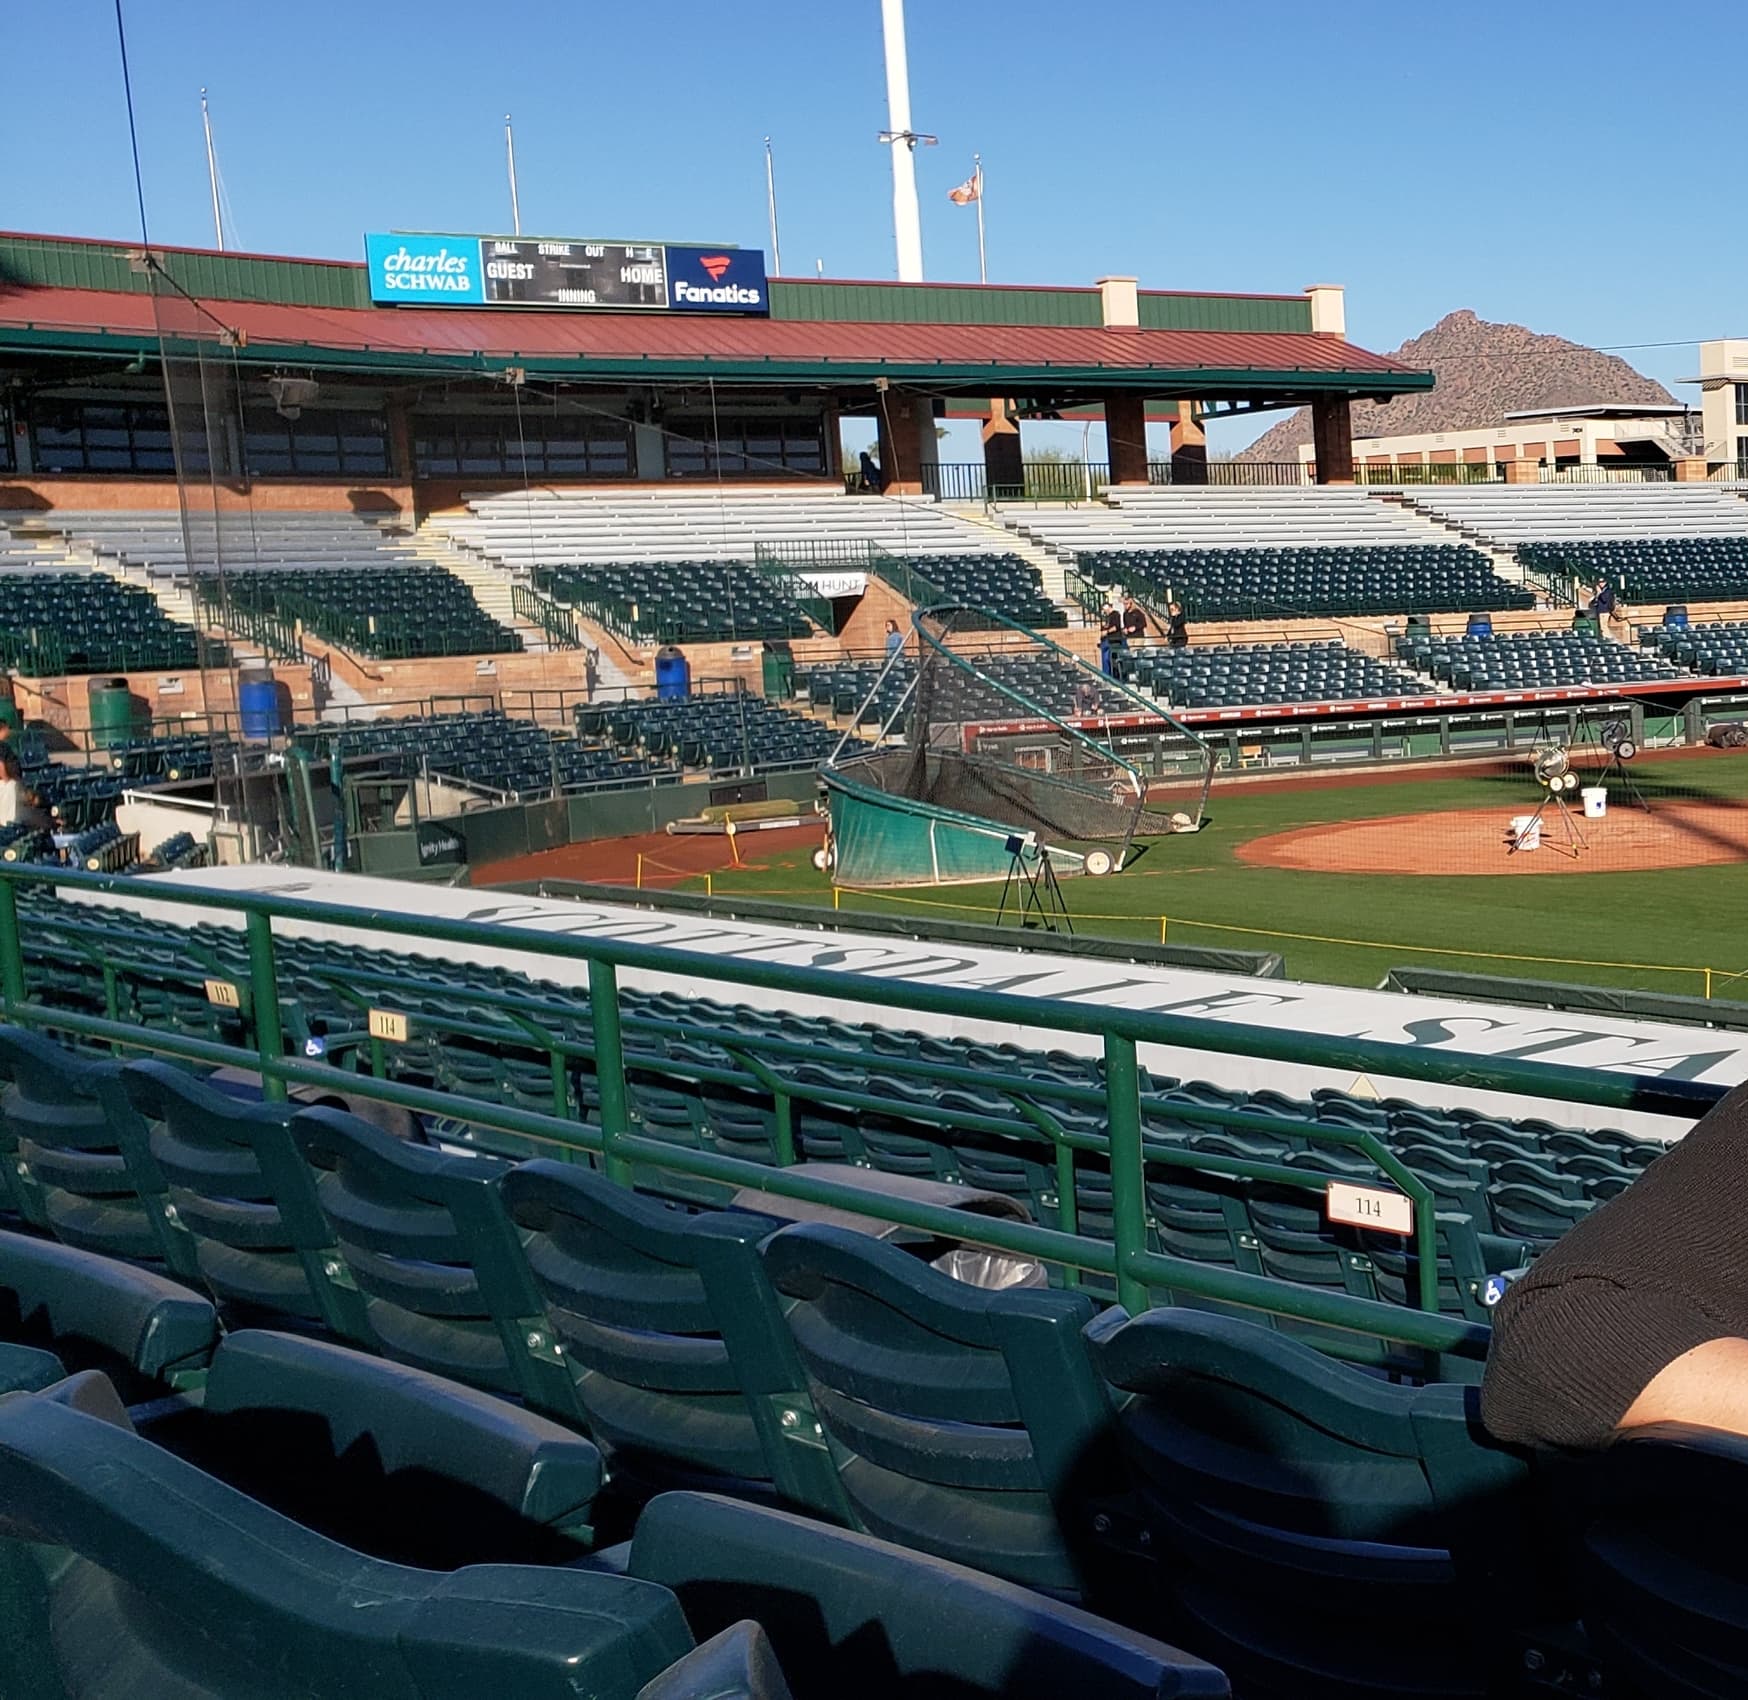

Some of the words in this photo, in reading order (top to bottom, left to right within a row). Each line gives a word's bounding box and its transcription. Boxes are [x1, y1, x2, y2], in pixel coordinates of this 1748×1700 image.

[494, 242, 519, 254] BALL
[537, 244, 571, 256] STRIKE
[585, 246, 605, 257] OUT
[625, 246, 634, 258] H
[383, 246, 468, 273] charles
[486, 262, 535, 280] GUEST
[620, 266, 664, 284] HOME
[384, 273, 471, 291] SCHWAB
[558, 289, 596, 303] INNING
[674, 281, 760, 304] Fanatics
[822, 579, 860, 590] HUNT
[214, 985, 231, 1003] 112
[379, 1016, 396, 1036] 114
[1355, 1197, 1382, 1217] 114
